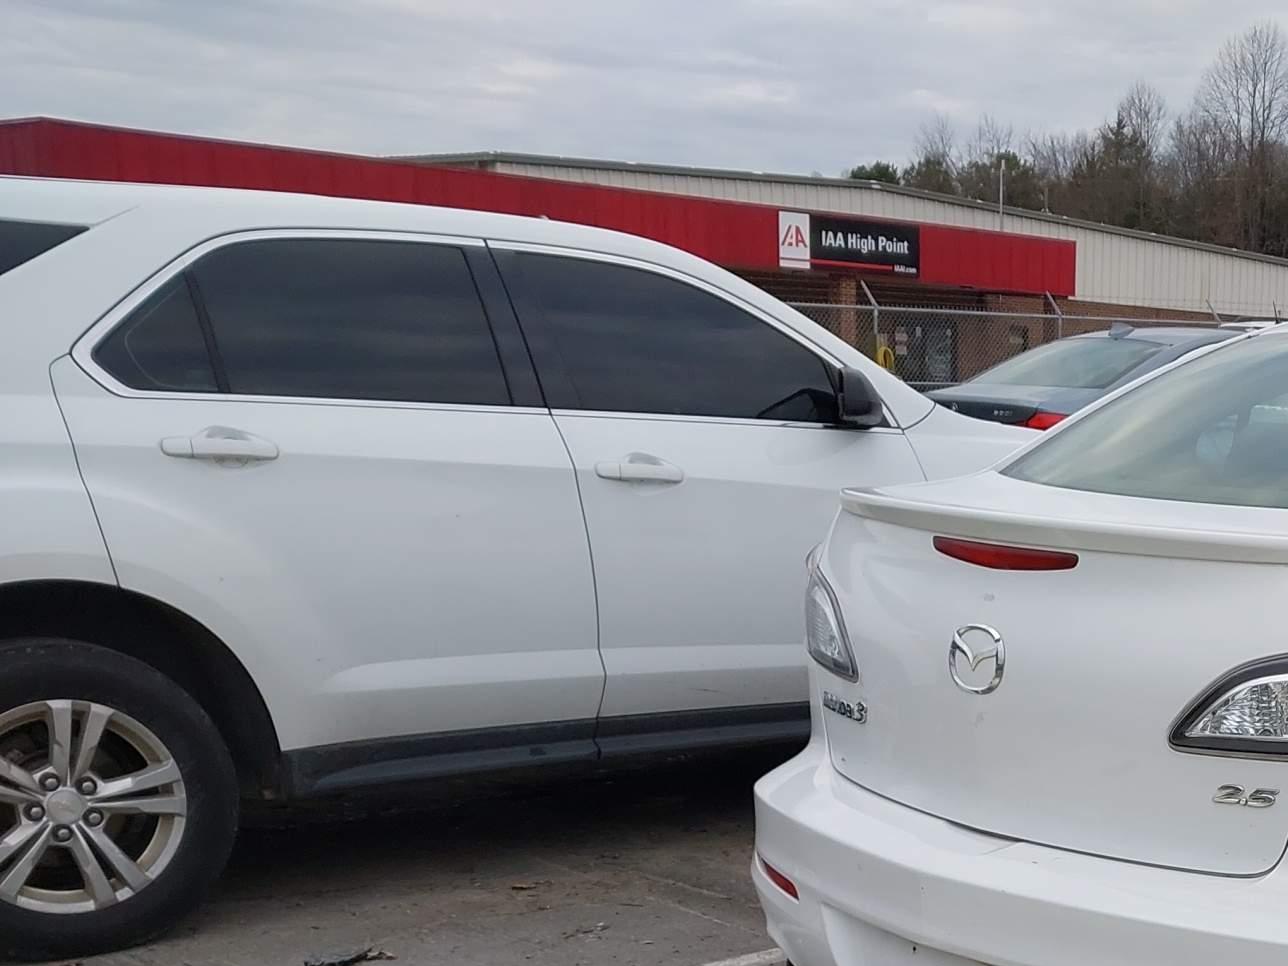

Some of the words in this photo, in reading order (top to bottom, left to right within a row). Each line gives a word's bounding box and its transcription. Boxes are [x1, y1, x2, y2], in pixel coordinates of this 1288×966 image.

[821, 230, 845, 248] IAA
[847, 232, 876, 254] High
[878, 235, 909, 254] Point
